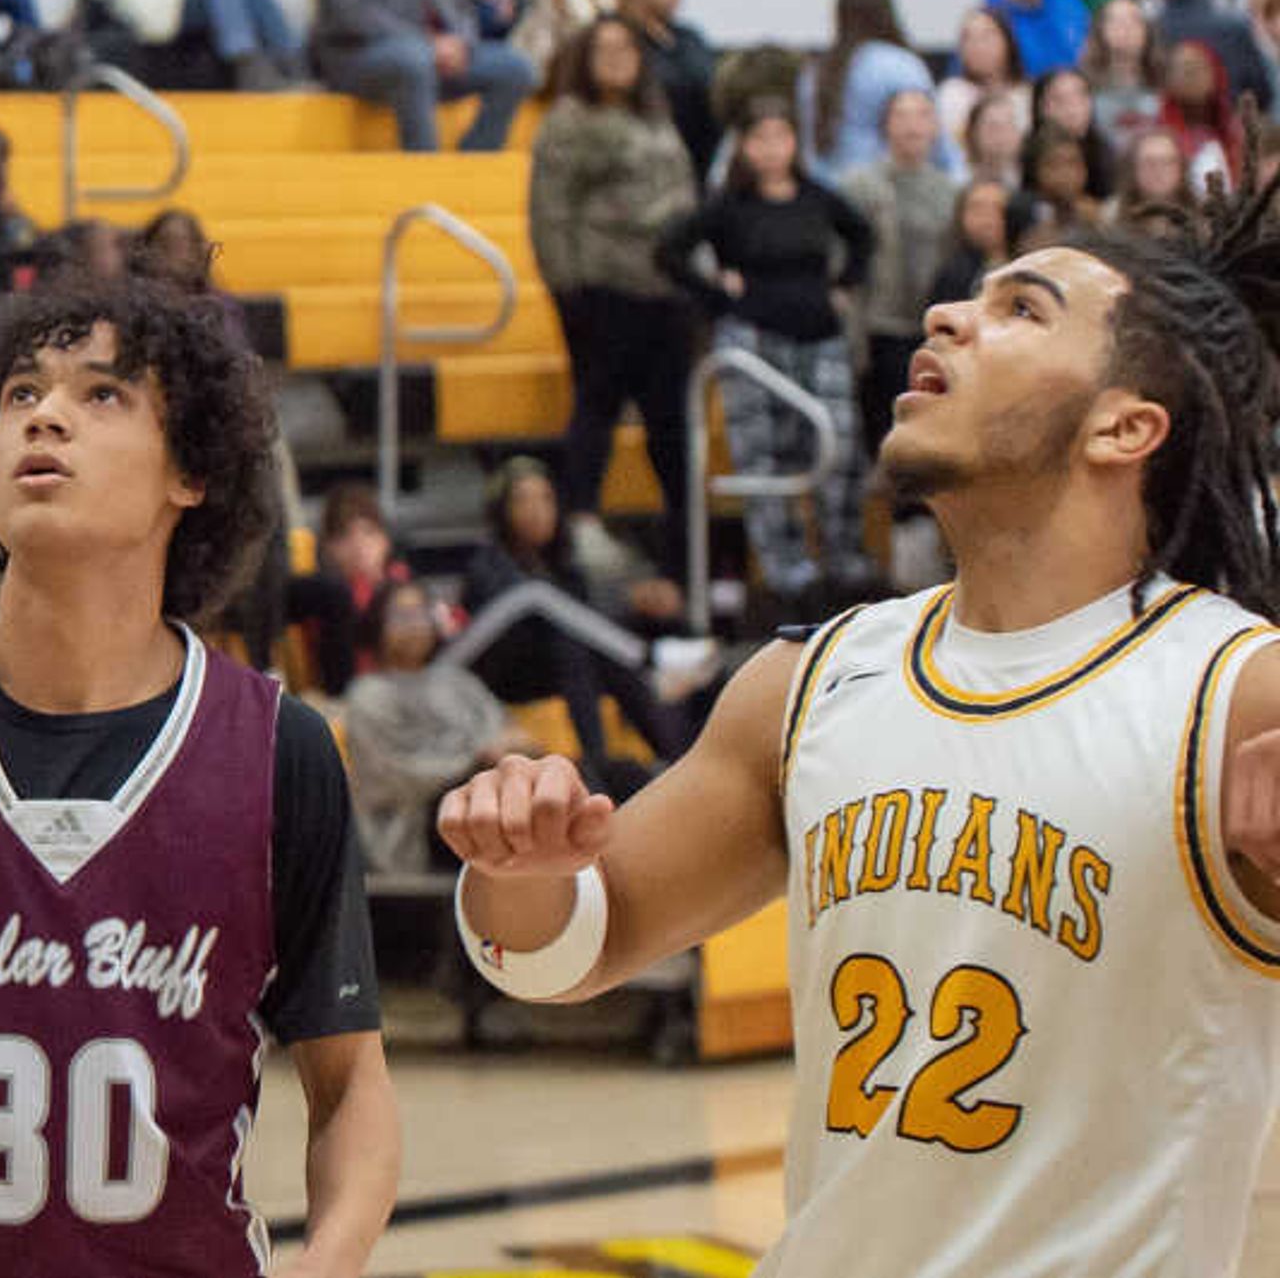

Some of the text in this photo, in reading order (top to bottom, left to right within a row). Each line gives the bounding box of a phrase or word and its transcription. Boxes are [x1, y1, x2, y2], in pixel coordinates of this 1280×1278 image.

[803, 787, 1112, 963] INDIANS
[82, 917, 220, 1021] Bluff
[826, 952, 1030, 1155] 22
